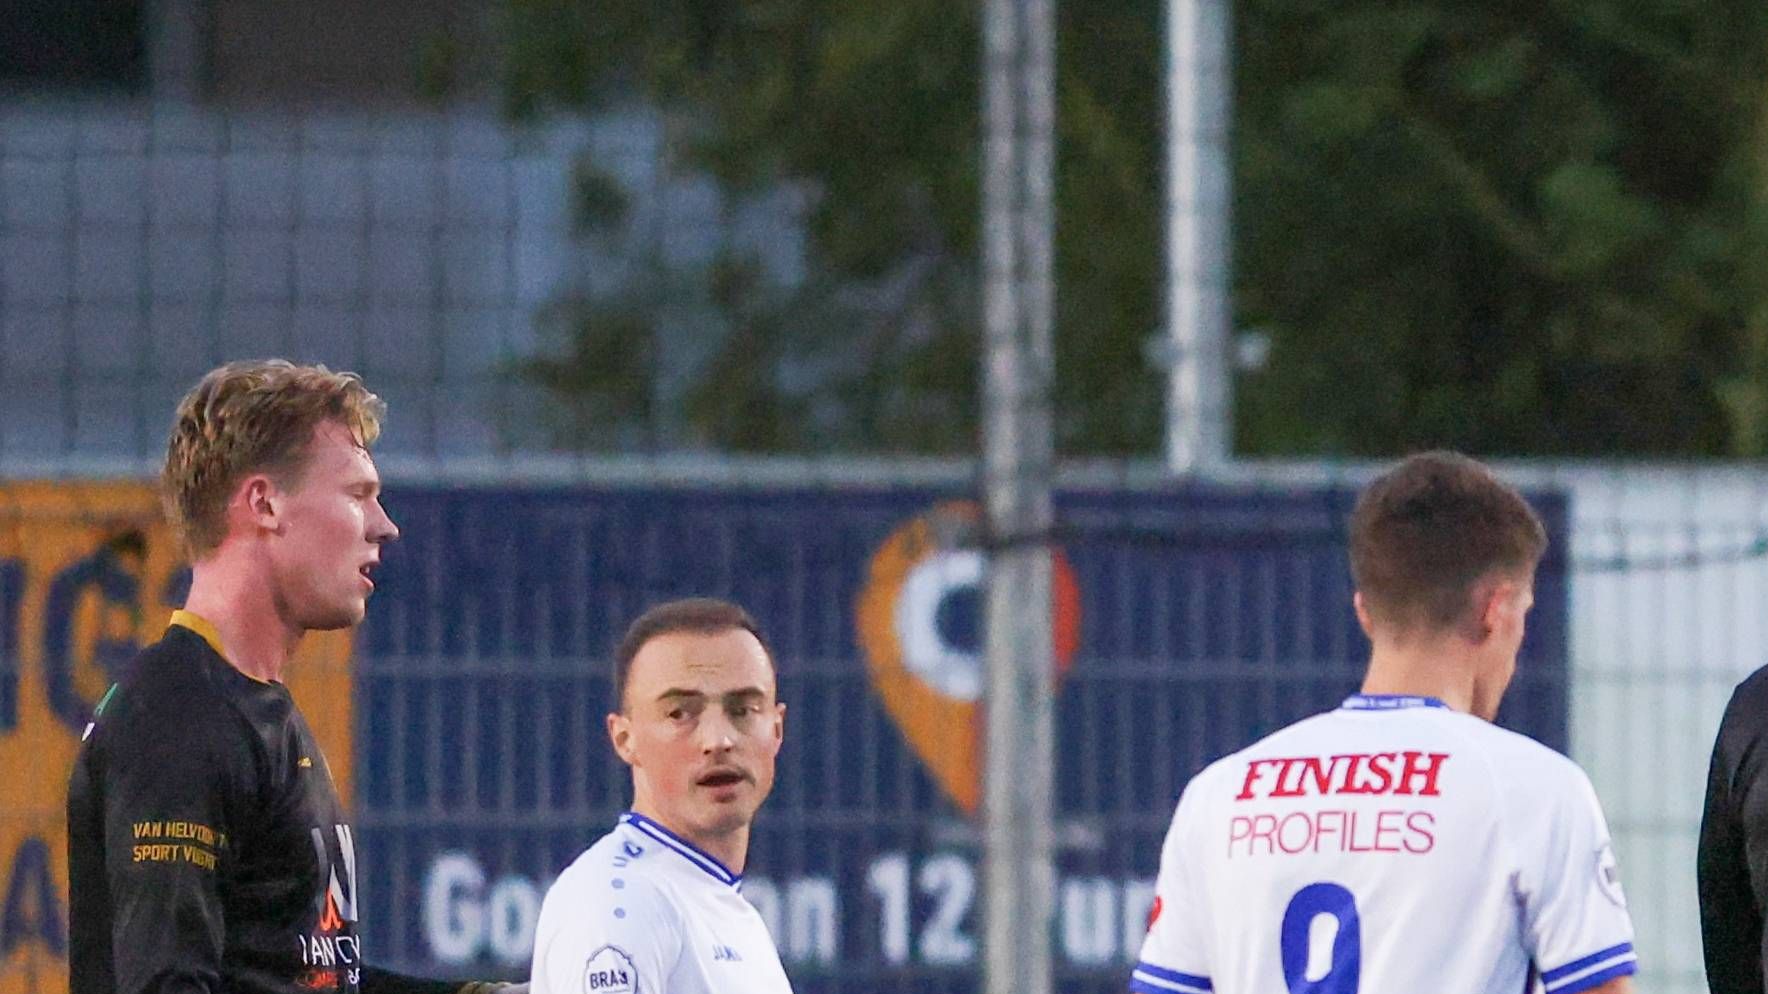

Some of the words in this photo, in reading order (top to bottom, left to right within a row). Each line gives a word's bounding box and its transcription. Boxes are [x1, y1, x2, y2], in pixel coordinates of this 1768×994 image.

[1235, 751, 1453, 801] FINISH
[133, 821, 161, 838] VAN
[133, 844, 178, 862] SPORT
[1228, 811, 1435, 858] PROFILES
[868, 854, 977, 962] 12
